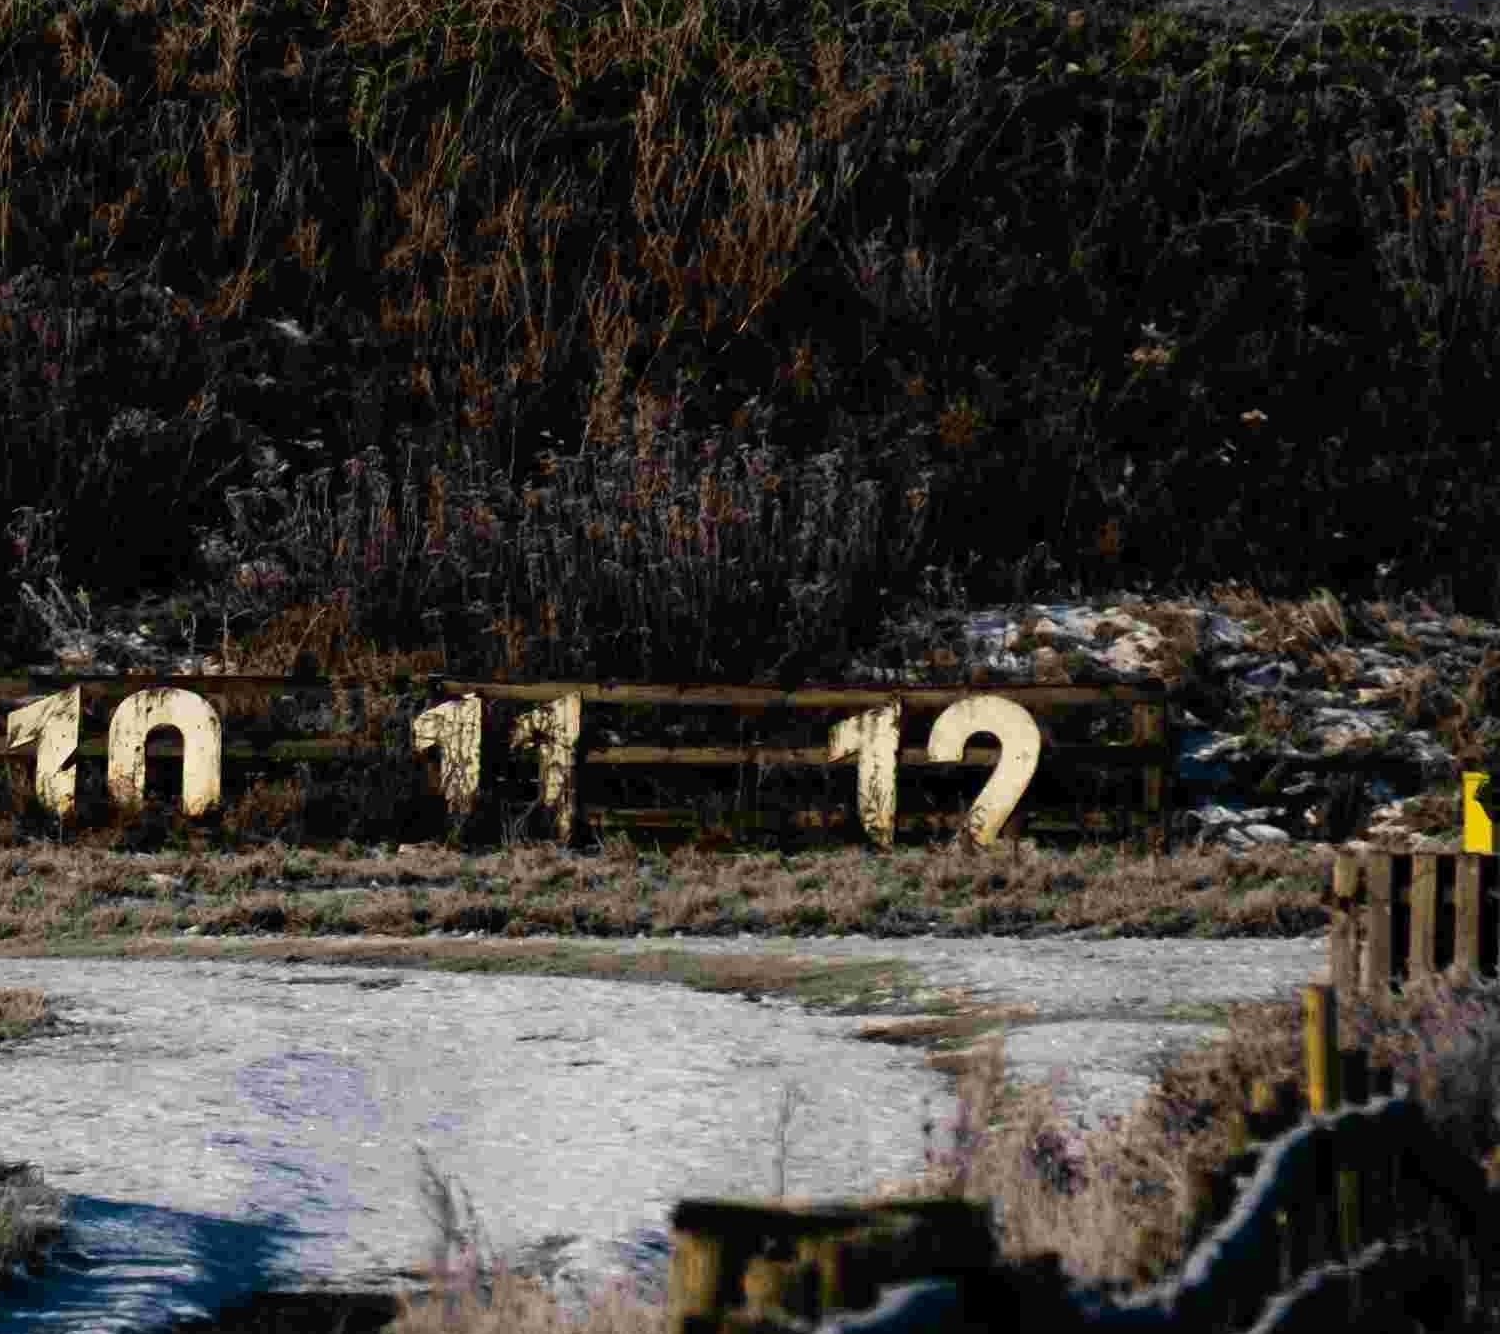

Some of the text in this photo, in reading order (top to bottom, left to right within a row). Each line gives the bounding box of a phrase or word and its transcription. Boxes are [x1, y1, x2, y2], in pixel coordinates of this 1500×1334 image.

[6, 685, 222, 817] 10
[412, 691, 582, 845] 11
[827, 694, 1041, 847] 12
